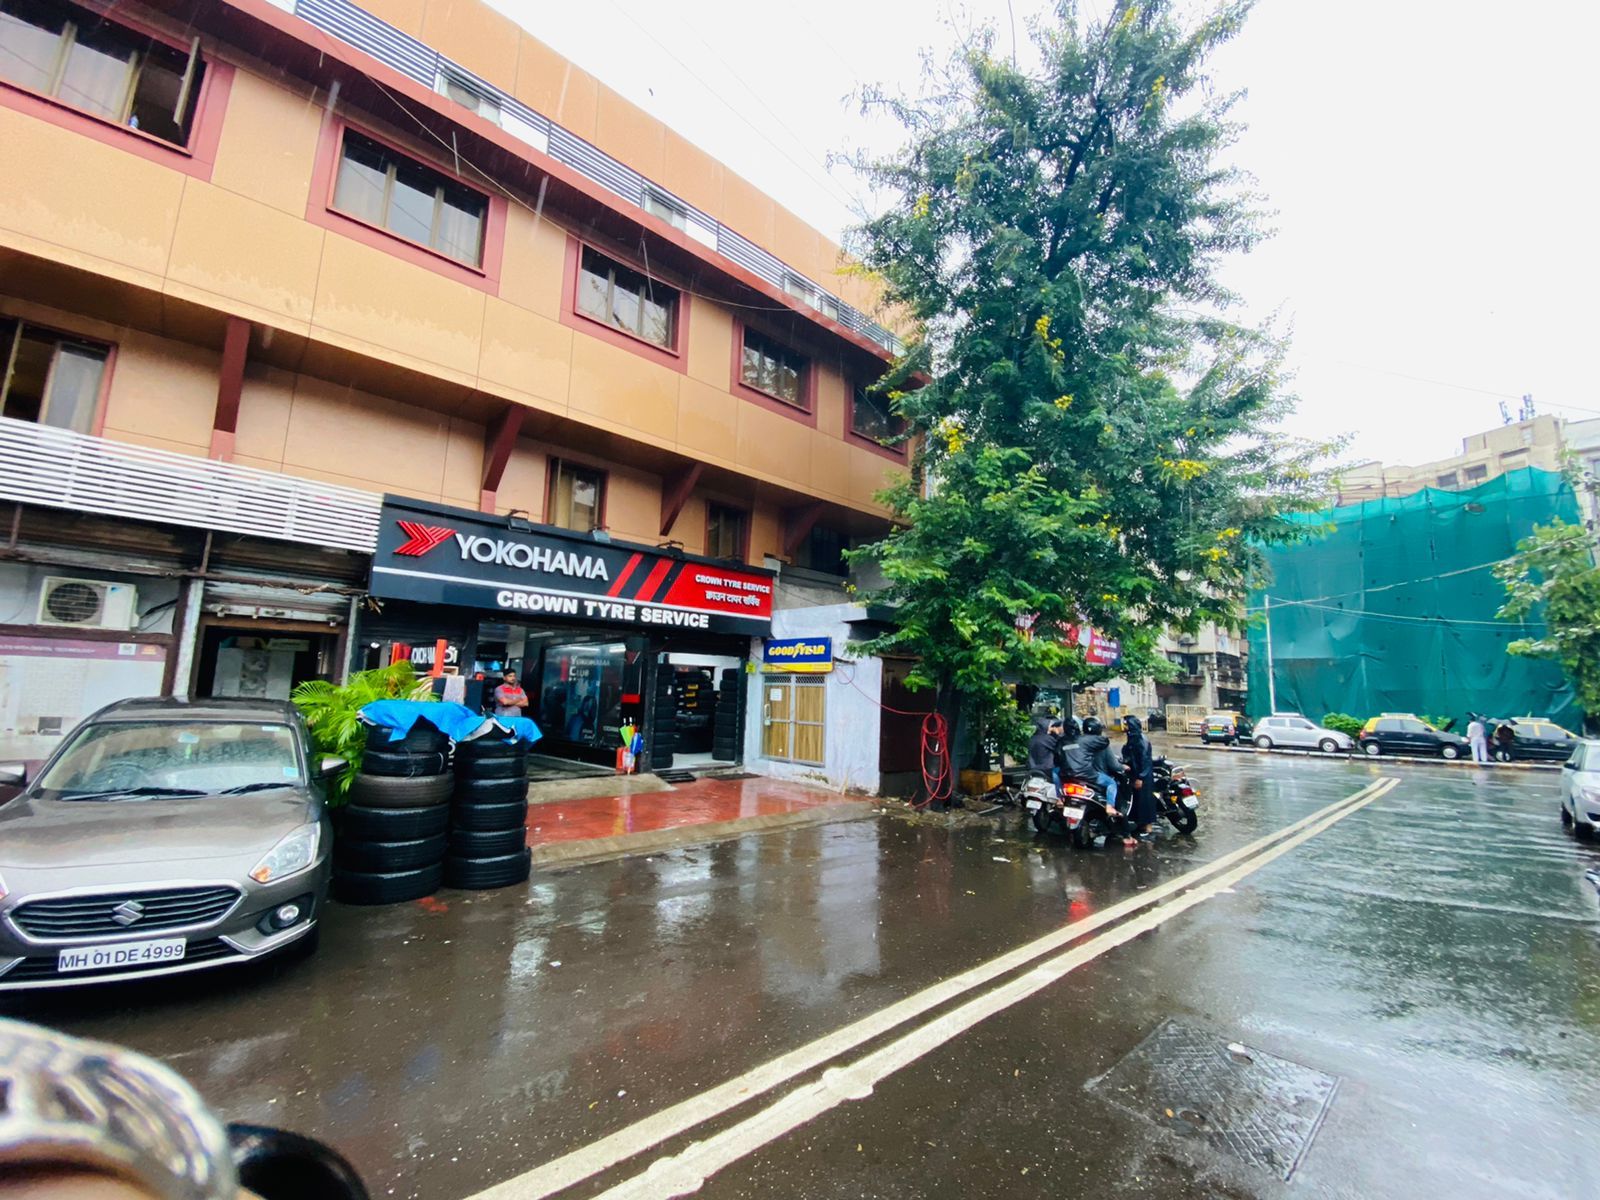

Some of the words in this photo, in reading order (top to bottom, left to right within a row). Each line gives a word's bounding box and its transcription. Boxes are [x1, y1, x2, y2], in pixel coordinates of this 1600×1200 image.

[454, 533, 609, 581] YOKOHAMA
[695, 574, 722, 586] CROWN
[723, 578, 742, 589] TYRE
[743, 582, 770, 594] SERVICE
[496, 590, 579, 615] CROWN
[583, 600, 636, 621] TYRE
[640, 607, 709, 629] SERVICE
[768, 642, 826, 659] GOODYEAR
[60, 954, 88, 969] MH
[93, 951, 111, 965] 01
[114, 949, 139, 963] DE
[141, 944, 184, 960] 4999
